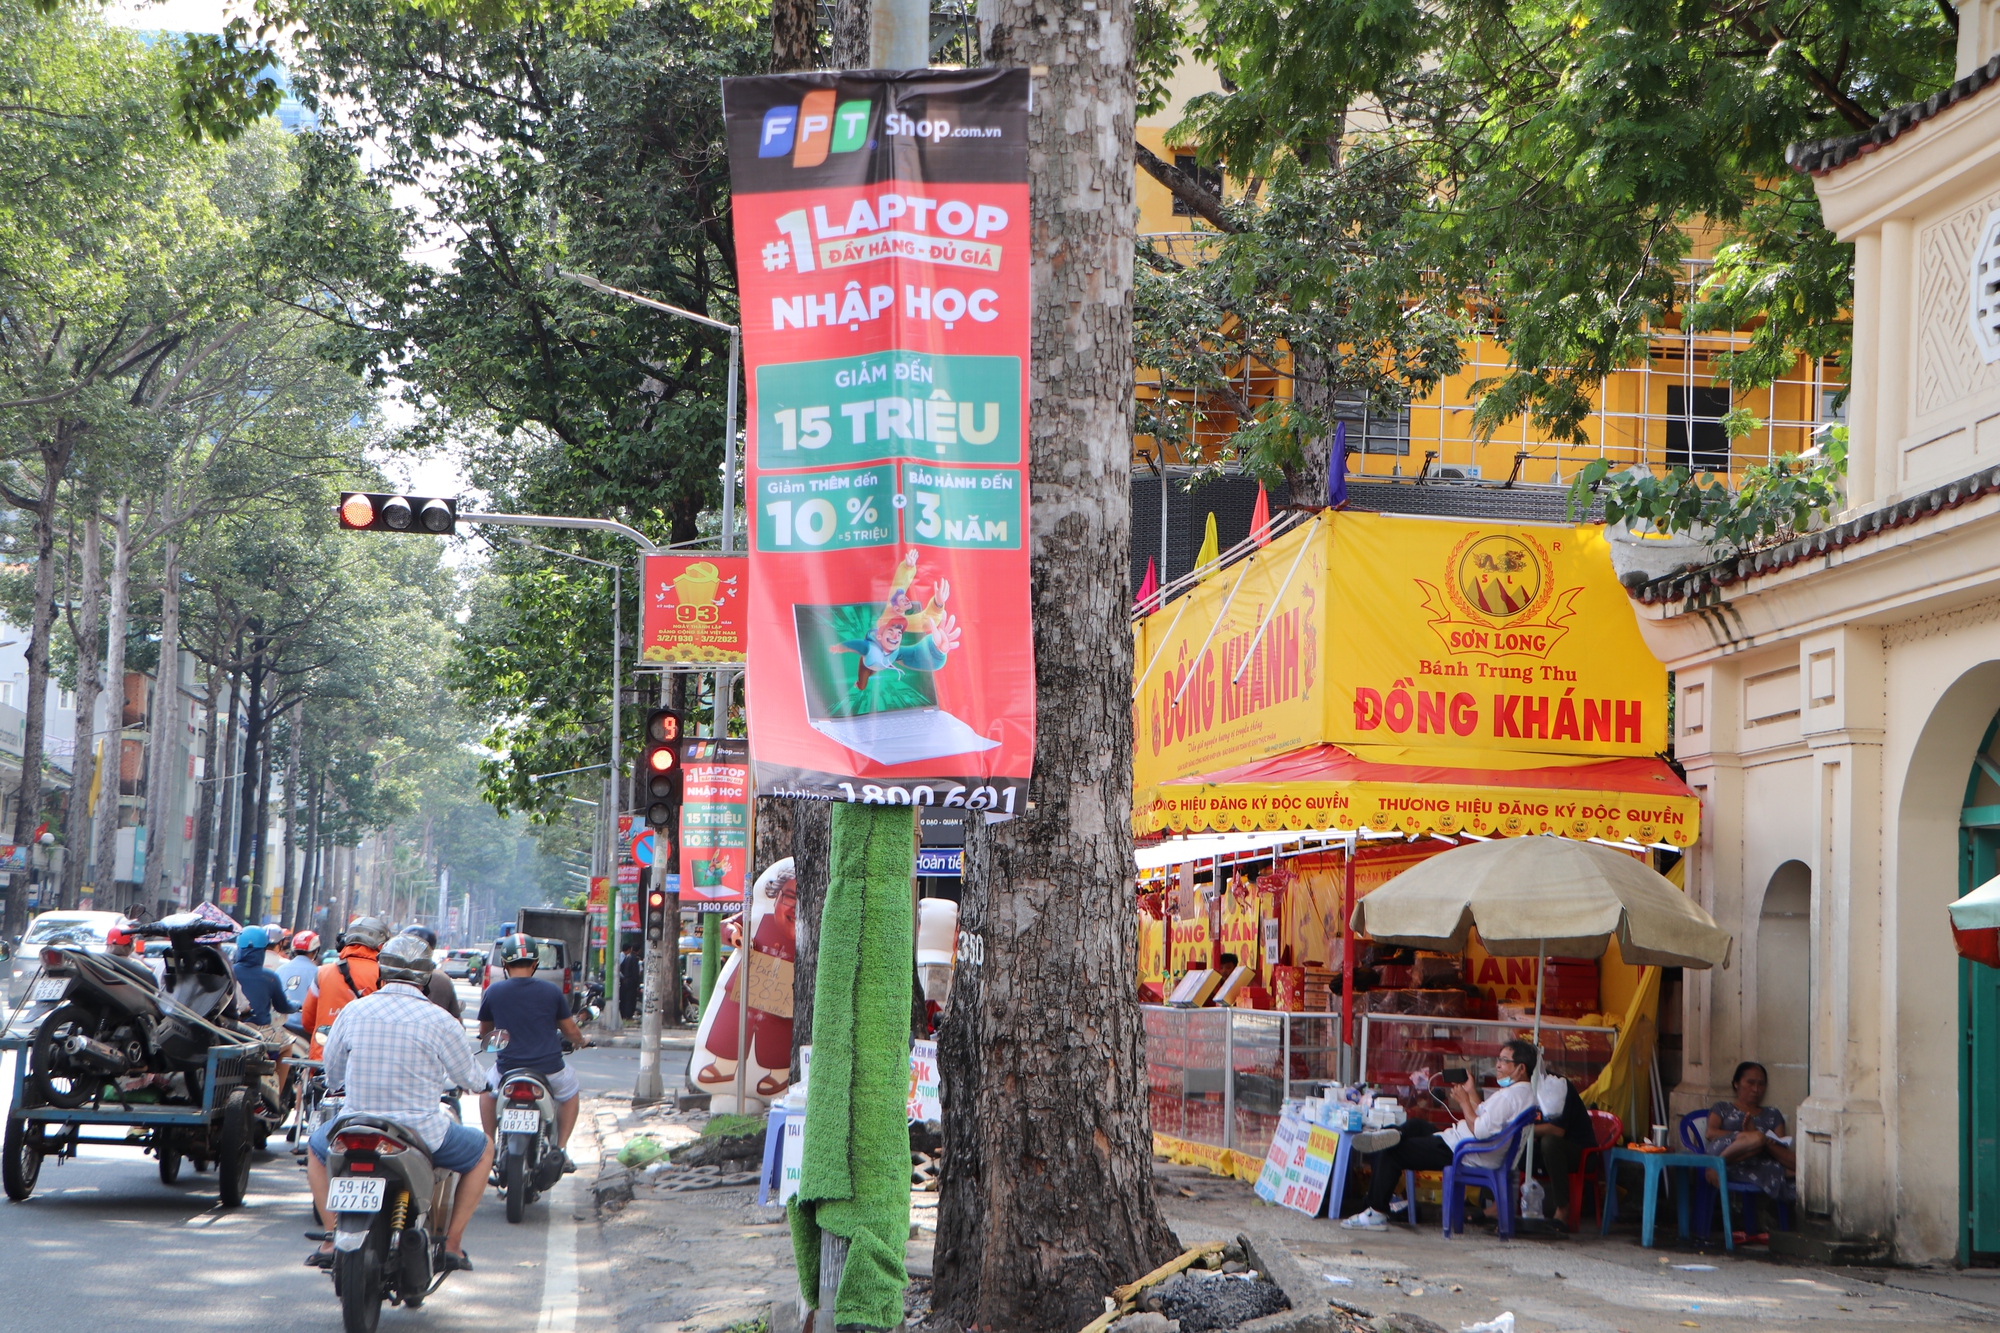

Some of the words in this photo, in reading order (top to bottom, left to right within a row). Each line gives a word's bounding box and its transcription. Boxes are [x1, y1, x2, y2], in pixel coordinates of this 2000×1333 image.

[760, 101, 870, 155] FPT
[762, 209, 816, 273] #1
[813, 194, 1008, 239] LAPTOP
[828, 240, 864, 264] ĐẦY
[869, 235, 915, 257] HÀNG
[929, 242, 954, 261] ĐỦ
[960, 246, 993, 267] GIÁ
[771, 280, 894, 332] NHẬP
[905, 284, 999, 330] HỌC
[835, 361, 887, 388] GIẢM
[894, 358, 933, 384] ĐẾN
[774, 405, 832, 451] 15
[840, 388, 1000, 455] TRIỆU
[767, 480, 805, 494] Giảm
[809, 475, 850, 491] THÊM
[854, 471, 878, 488] đến
[909, 469, 933, 486] BẢO
[935, 471, 977, 489] HÀNH
[980, 470, 1013, 490] ĐẾN
[766, 498, 838, 546] 10
[847, 495, 878, 526] %
[915, 491, 942, 539] 3
[944, 514, 1007, 542] NĂM
[854, 527, 889, 541] TRIỆU
[676, 603, 719, 624] 93
[701, 635, 738, 643] 3/2/2023
[1450, 629, 1489, 649] SƠN
[1494, 633, 1547, 652] LONG
[1163, 638, 1215, 748] ĐỒNG
[1221, 603, 1300, 724] KHÁNH
[1419, 659, 1469, 677] Bánh
[1475, 662, 1533, 684] Trung
[1539, 665, 1577, 682] Thu
[1353, 676, 1479, 738] ĐỒNG
[1493, 687, 1642, 743] KHÁNH
[664, 716, 676, 740] 9
[688, 744, 714, 756] FPT
[699, 766, 746, 777] LAPTOP
[687, 785, 718, 798] NHẬP
[720, 787, 742, 798] HỌC
[1180, 795, 1207, 814] HIỆU
[1210, 794, 1248, 810] ĐĂNG
[1252, 794, 1268, 810] KÝ
[1272, 795, 1302, 814] ĐỘC
[1305, 791, 1349, 810] QUYỀN
[1378, 797, 1450, 812] THƯƠNG
[1455, 798, 1493, 816] HIỆU
[1498, 801, 1549, 817] ĐĂNG
[1555, 802, 1576, 819] KÝ
[1581, 804, 1621, 823] ĐỘC
[1626, 805, 1684, 825] QUYỀN
[686, 813, 701, 824] 15
[702, 811, 742, 826] TRIỆU
[926, 819, 938, 827] ĐẠO
[942, 818, 959, 827] QUẬN
[684, 834, 702, 846] 10
[719, 834, 728, 846] 3
[728, 839, 744, 847] NĂM
[916, 854, 945, 869] Hoàn
[697, 902, 721, 911] 1800
[756, 957, 780, 979] bánh
[503, 1120, 537, 1130] 087.55
[508, 1110, 534, 1120] 59-L3
[788, 1124, 800, 1136] TAI
[786, 1167, 800, 1179] TAI
[338, 1180, 376, 1194] 59-H2
[331, 1194, 379, 1209] 027.69
